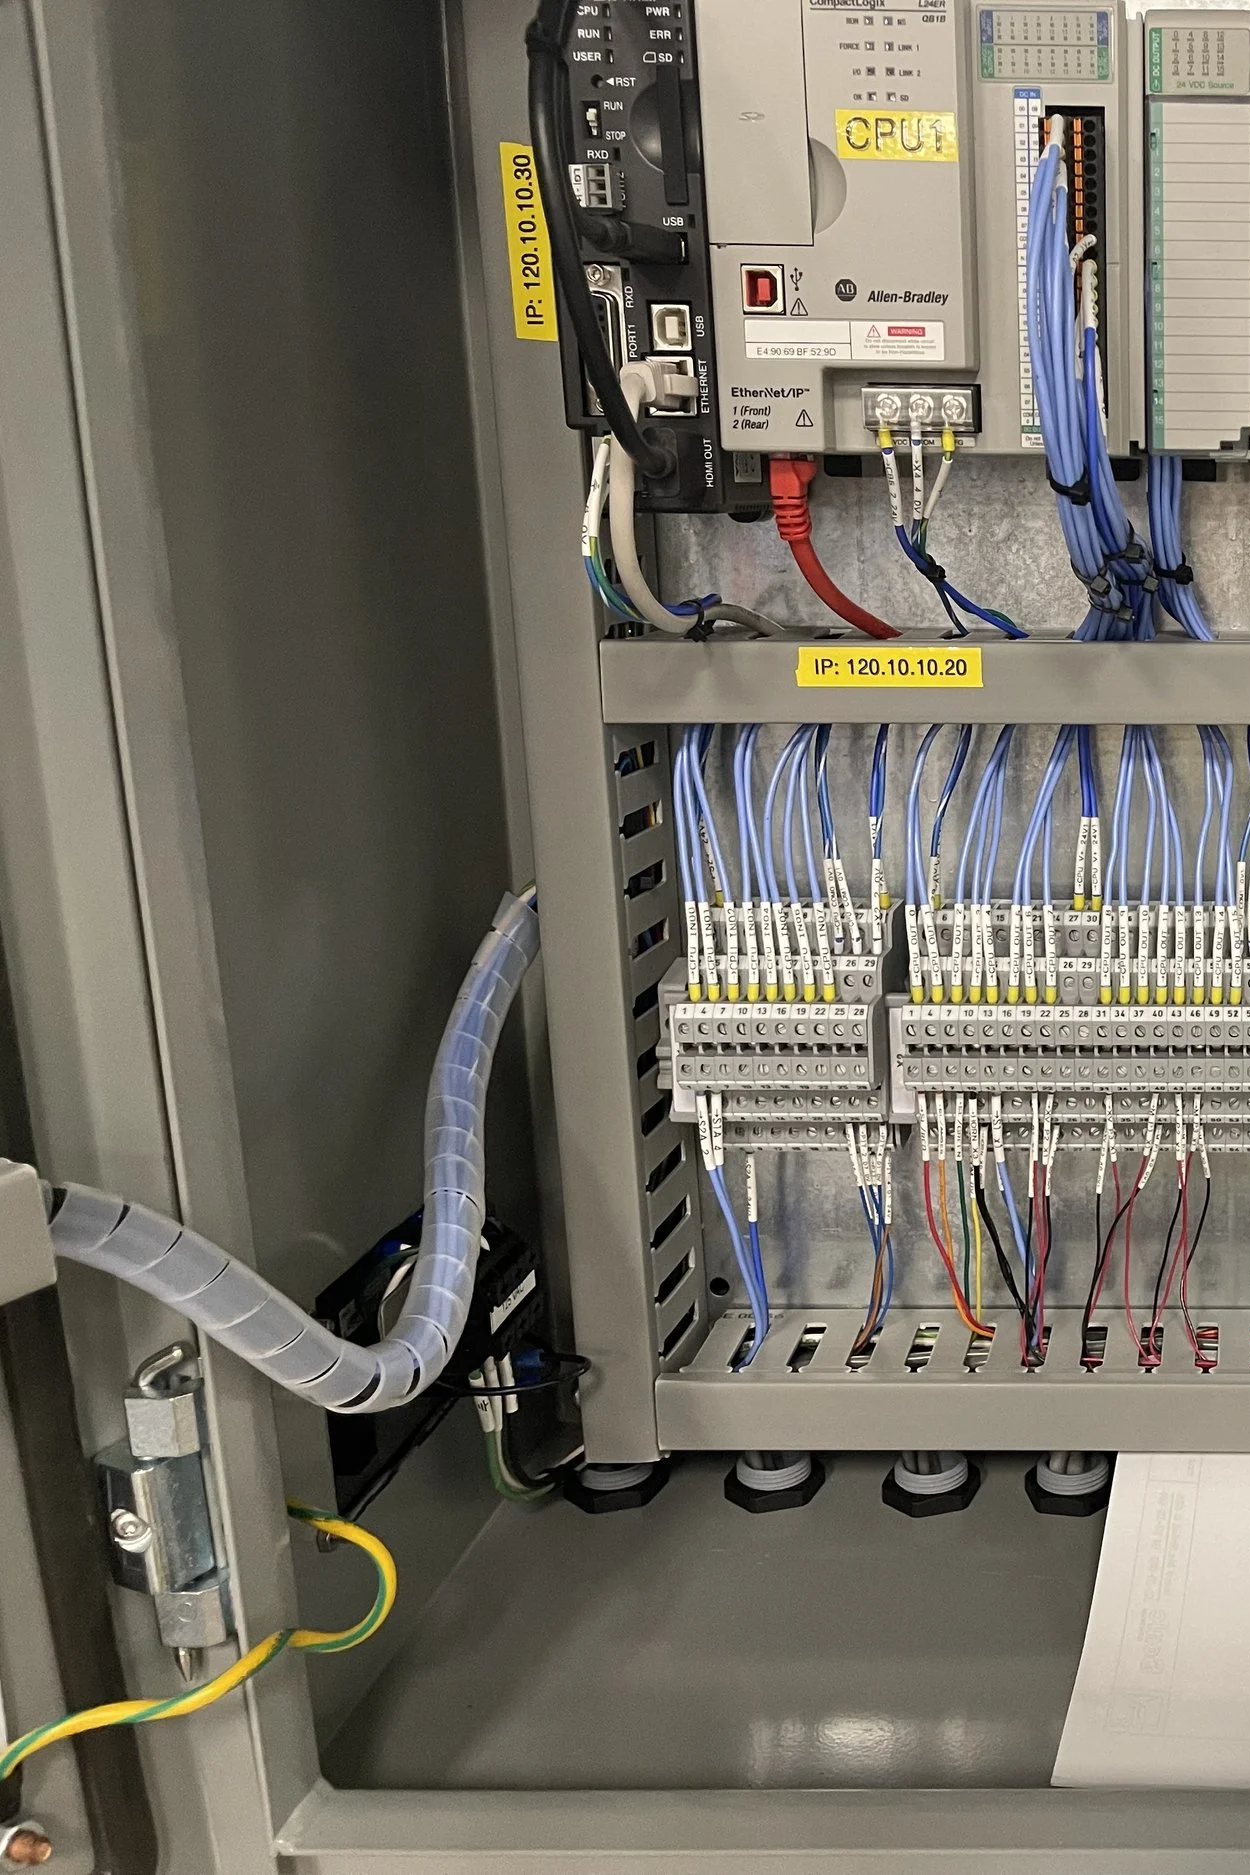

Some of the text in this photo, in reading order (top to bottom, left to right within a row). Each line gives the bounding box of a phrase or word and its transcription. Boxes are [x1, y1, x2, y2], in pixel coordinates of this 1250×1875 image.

[645, 7, 670, 17] PWR
[577, 29, 600, 39] RUN
[649, 30, 671, 40] ERR
[573, 52, 601, 62] USER
[658, 53, 673, 63] SD
[616, 77, 636, 87] RST
[603, 101, 623, 110] RUN
[605, 131, 626, 140] STOP
[845, 117, 943, 152] CPU1
[587, 150, 609, 159] RXD
[662, 217, 684, 226] USB
[513, 154, 544, 325] IP: 120.10.10.30
[625, 286, 634, 308] RXD
[867, 290, 949, 305] Allen-Bradley
[696, 315, 705, 337] USB
[629, 324, 638, 357] PORT1
[698, 360, 710, 414] ETHERNET
[740, 406, 771, 417] (Front)
[732, 420, 769, 431] 2 (Rear)
[704, 438, 714, 488] HDMI OUT
[815, 658, 967, 676] IP: 120.10.10.20
